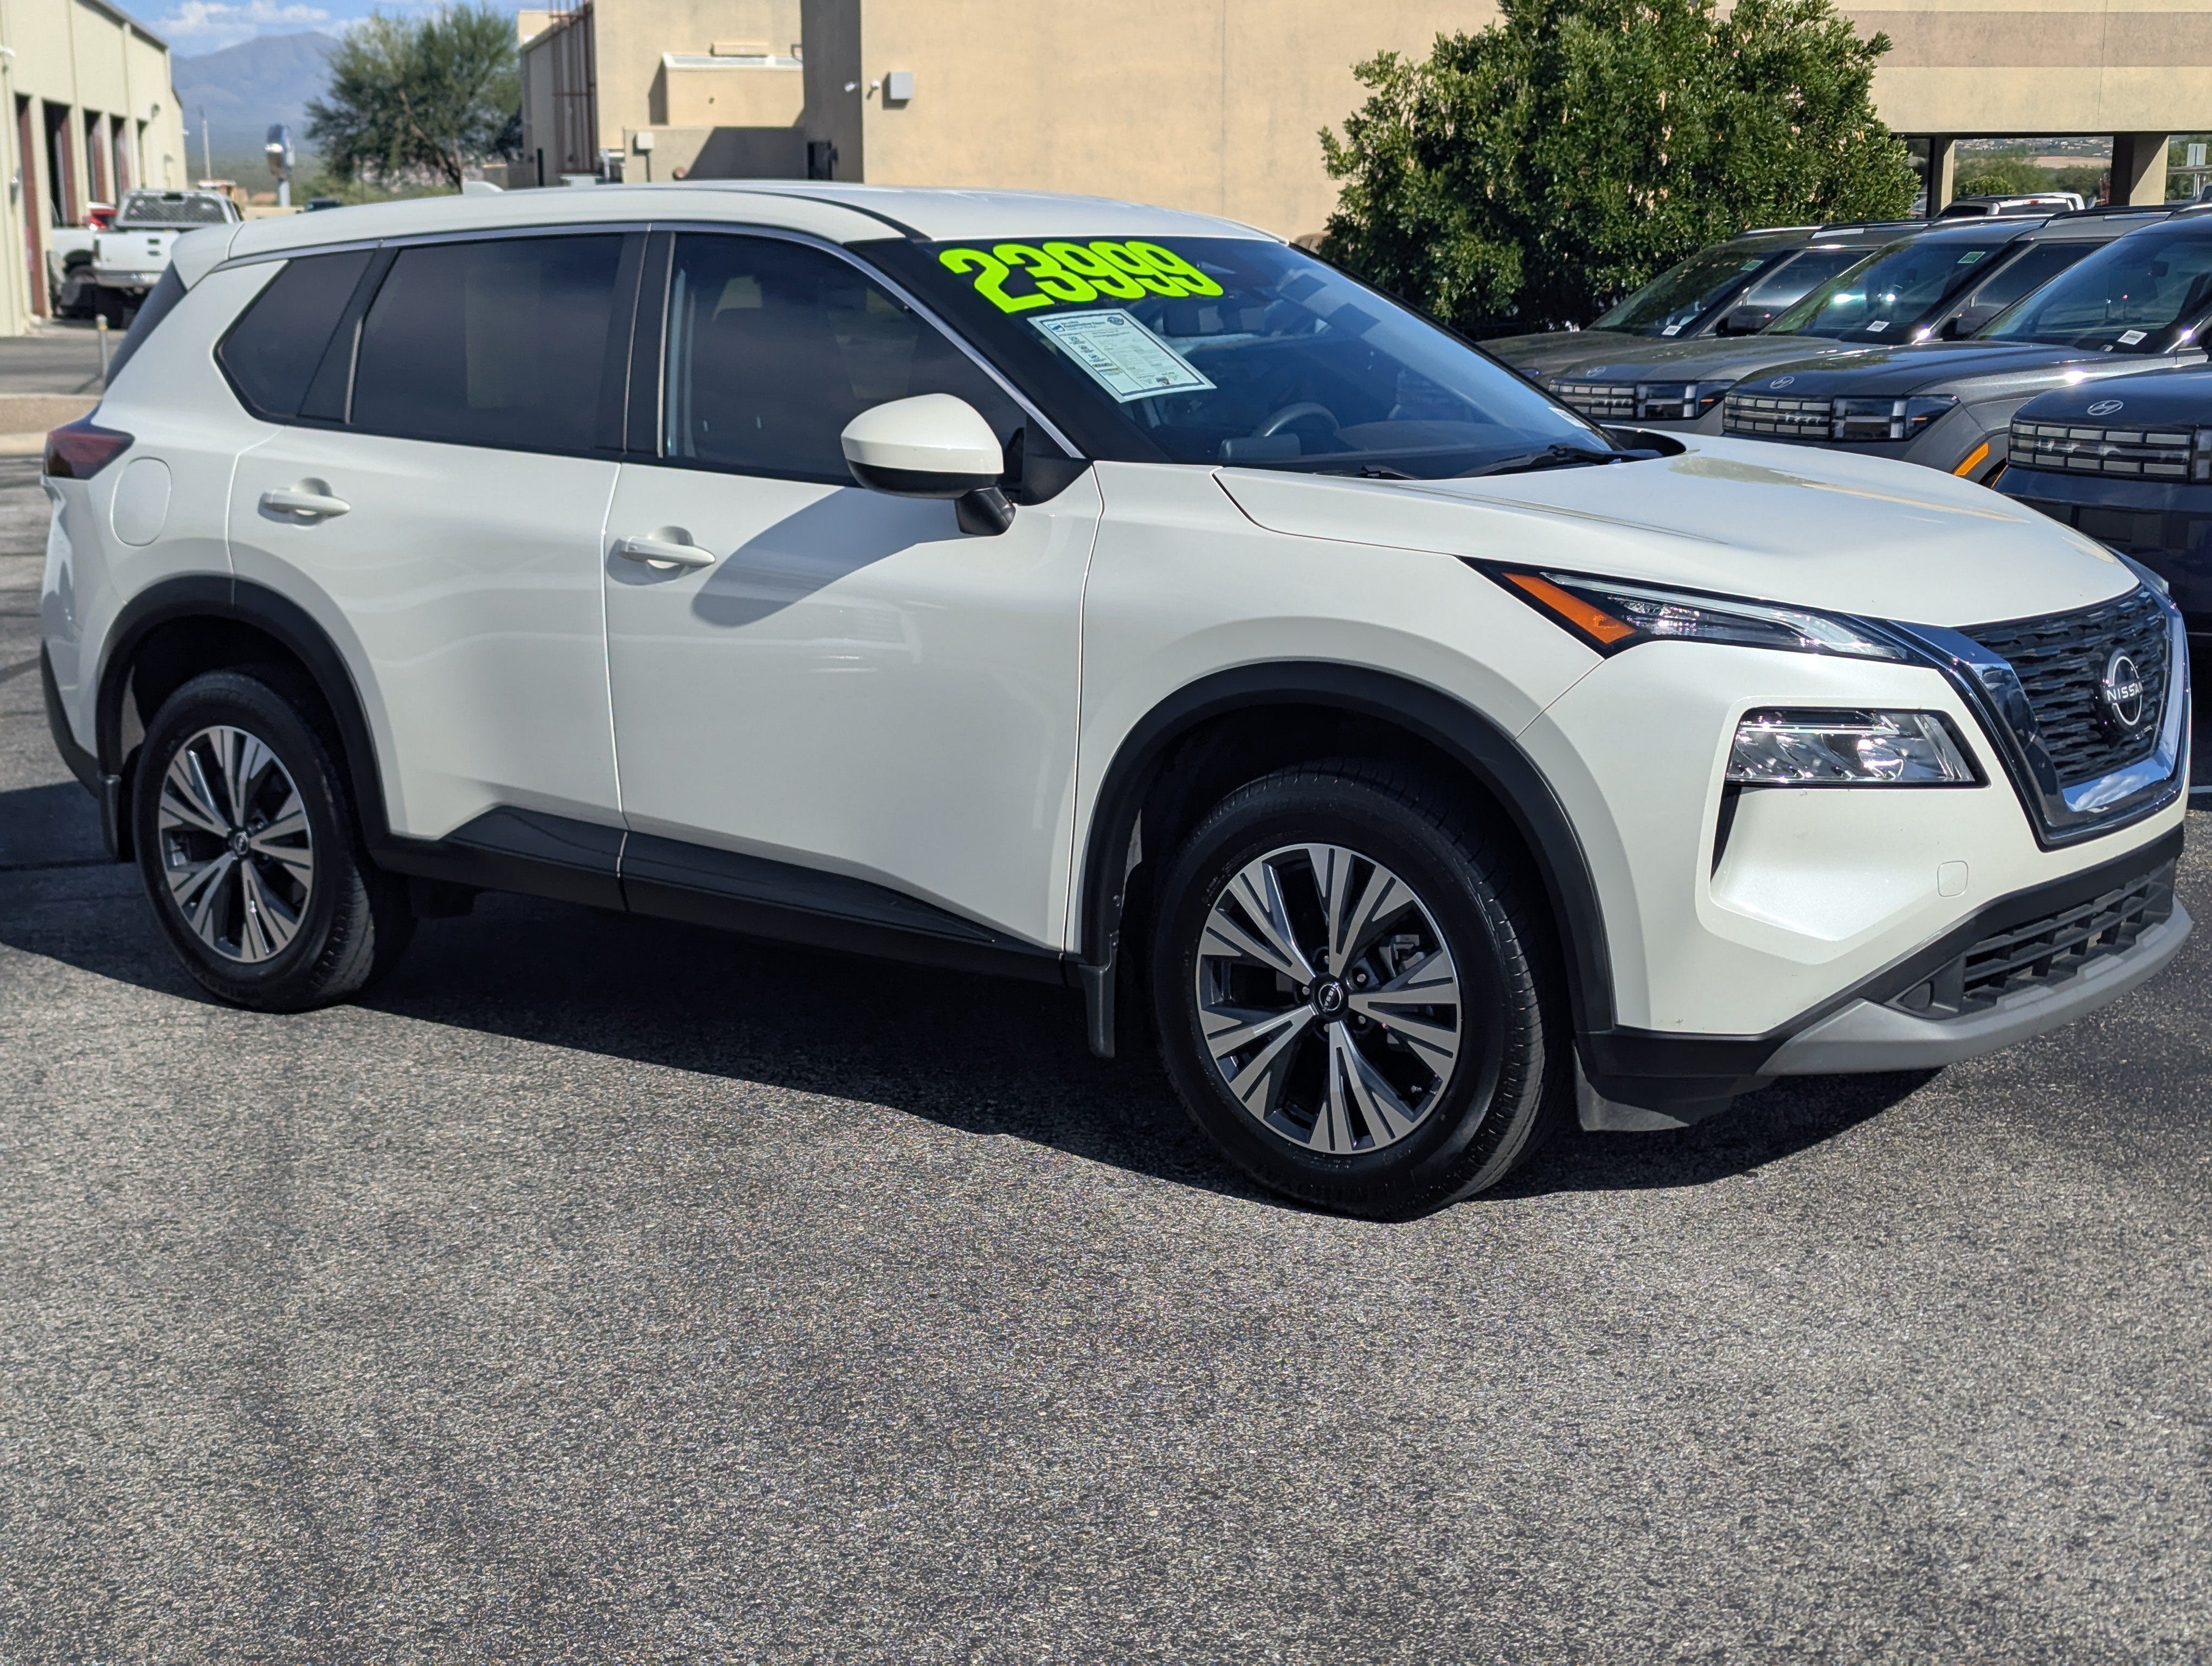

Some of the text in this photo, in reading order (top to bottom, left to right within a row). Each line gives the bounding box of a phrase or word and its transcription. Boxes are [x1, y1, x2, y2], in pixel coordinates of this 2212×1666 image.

[939, 240, 1224, 314] 23999
[2106, 681, 2143, 701] NISSAN
[1322, 982, 1339, 1013] NISSAN
